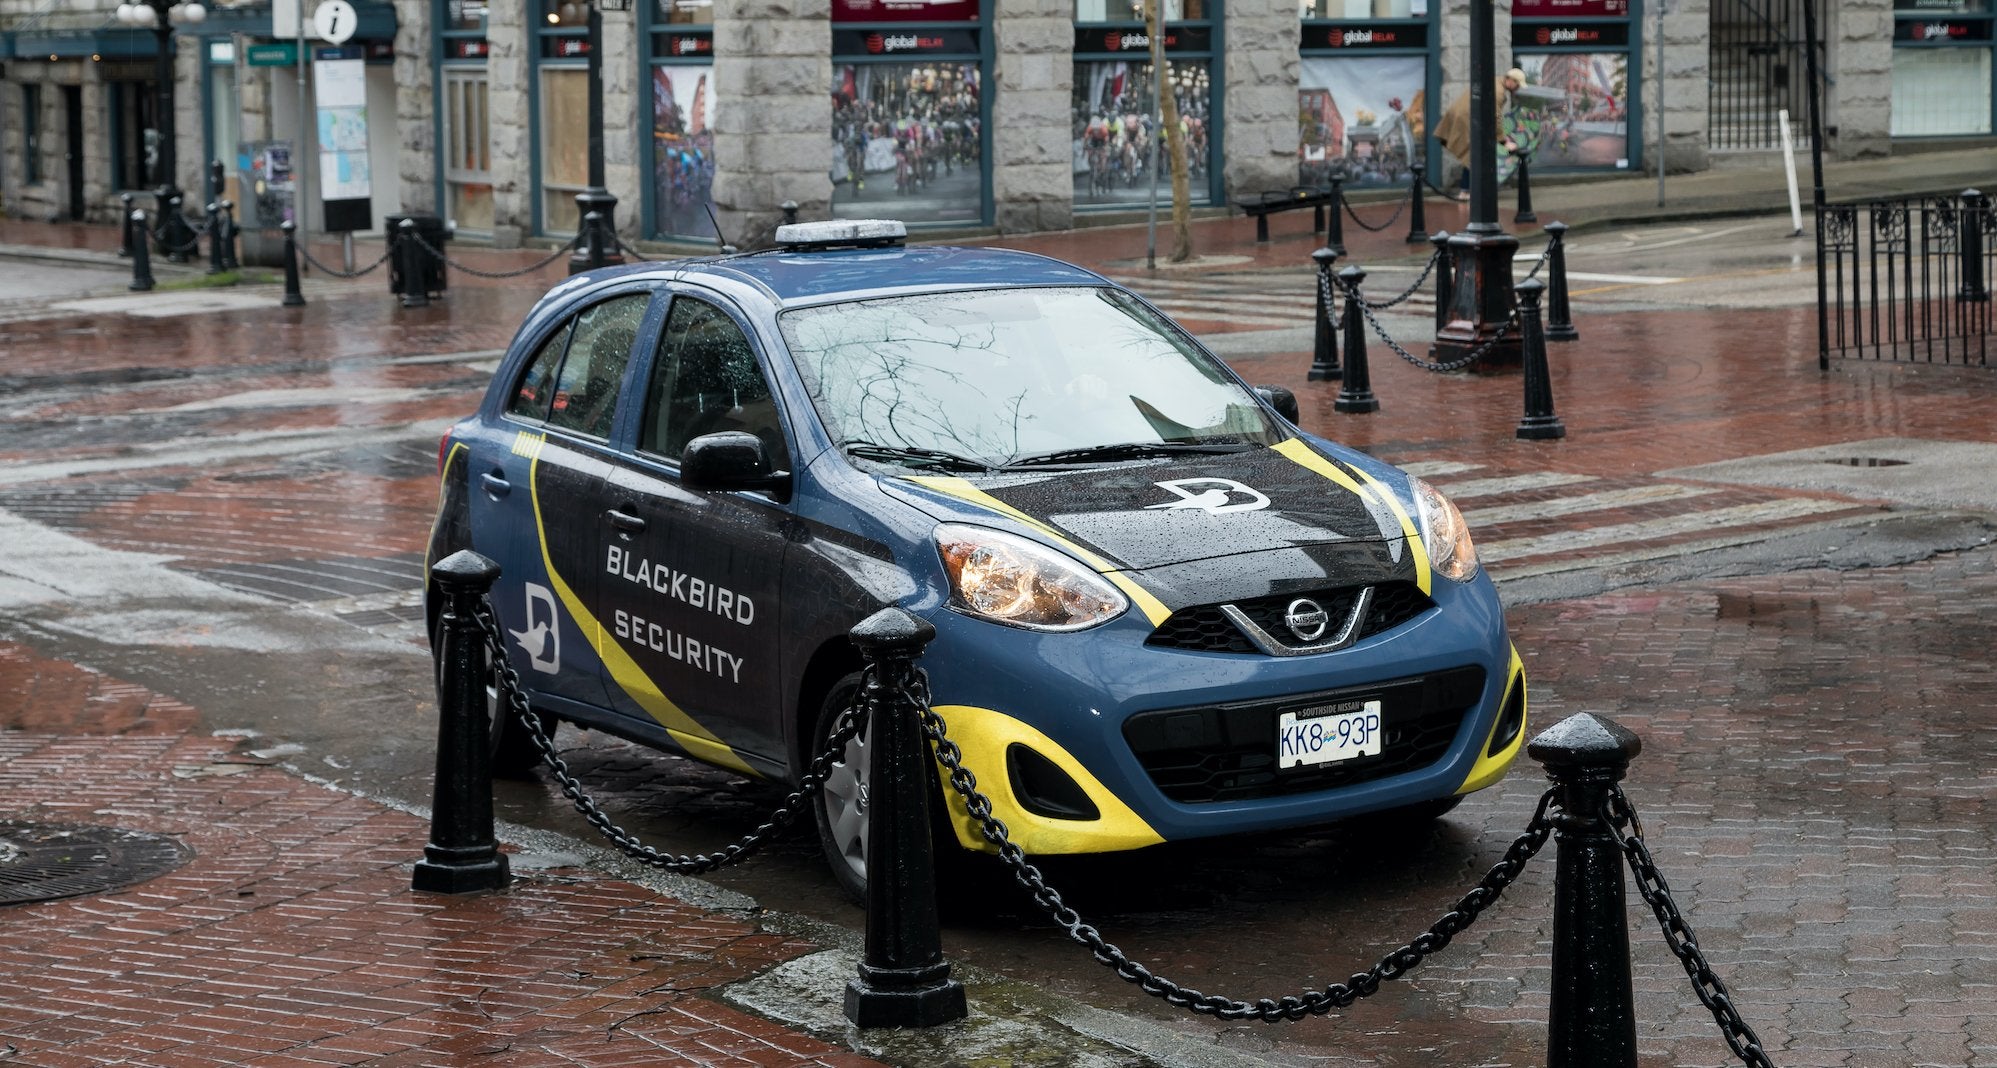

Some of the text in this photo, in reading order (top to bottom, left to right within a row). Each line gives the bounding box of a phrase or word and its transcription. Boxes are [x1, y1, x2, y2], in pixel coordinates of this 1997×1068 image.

[606, 544, 755, 626] BLACKBIRD
[614, 609, 744, 684] SECURITY
[1281, 714, 1379, 757] KK8 93P
[1302, 704, 1337, 717] SOUTHSIDE
[1337, 701, 1360, 713] NISSAN
